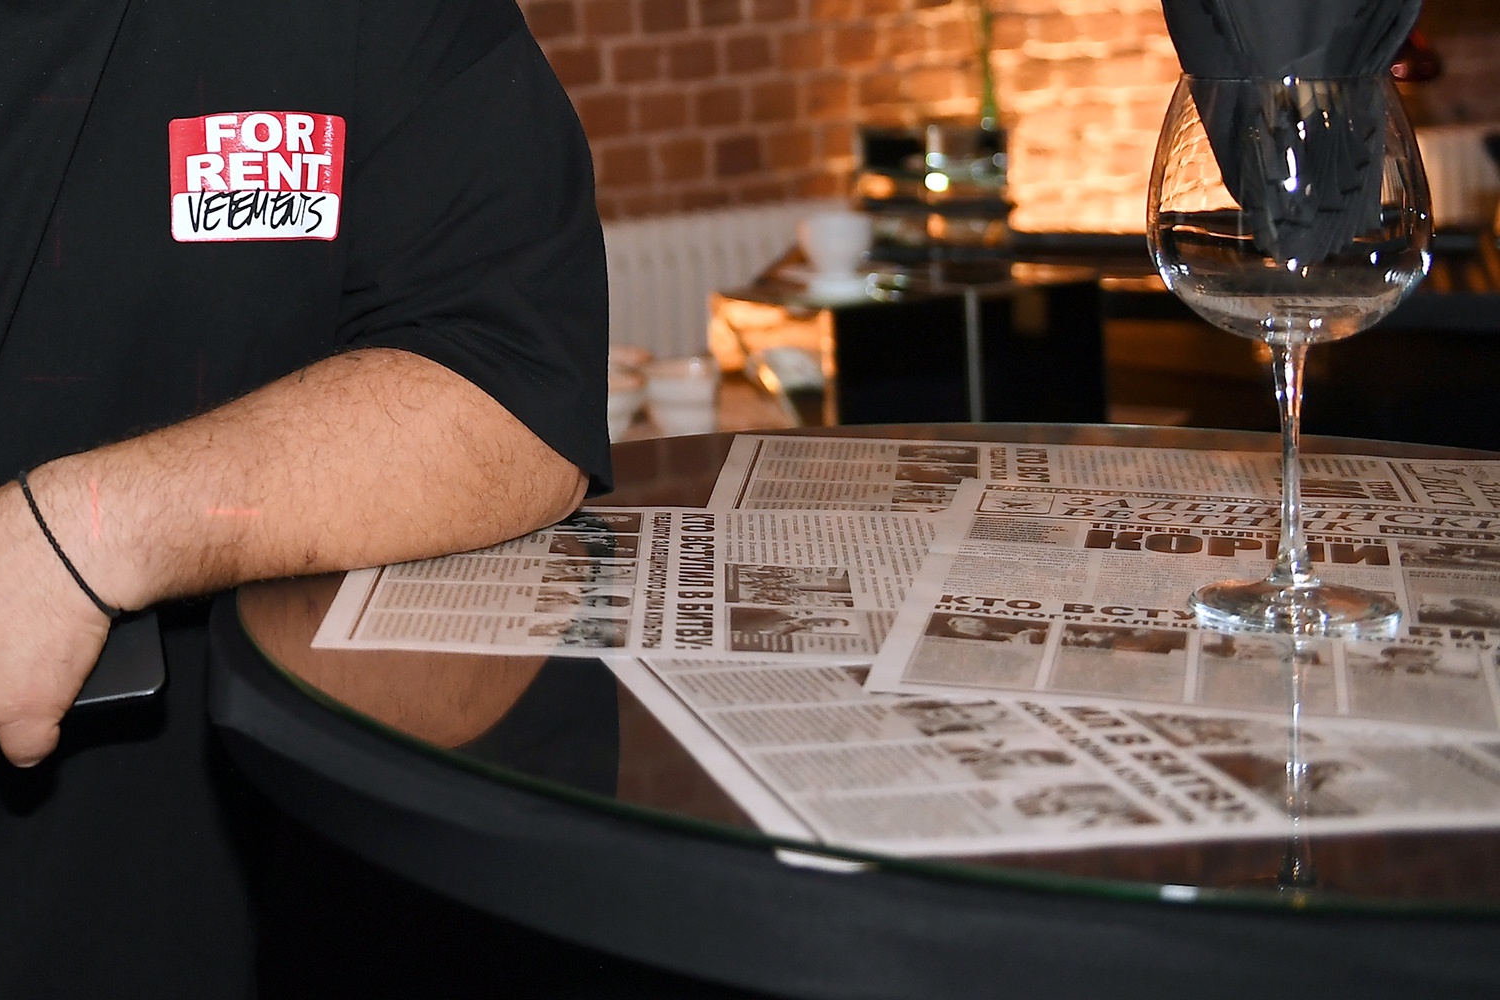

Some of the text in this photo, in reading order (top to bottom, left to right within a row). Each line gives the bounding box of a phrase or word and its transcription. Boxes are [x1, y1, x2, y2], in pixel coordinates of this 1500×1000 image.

[205, 113, 315, 153] FOR
[186, 152, 332, 191] RENT
[188, 188, 326, 233] VETEMENTS
[1016, 447, 1049, 464] КТО
[990, 484, 1083, 494] ГЛАВНАЯ
[650, 512, 672, 539] ПЕДАГОГИ
[680, 513, 715, 533] КТО
[1058, 507, 1363, 533] ВЕСТНИК
[1084, 529, 1390, 566] КОРНИ
[1201, 528, 1386, 545] КУЛЬРНЫЕ
[678, 535, 715, 587] ВСТУПИЛ
[643, 589, 666, 610] ДОМА
[677, 590, 714, 599] В
[934, 604, 1081, 621] ПЕДАГОГИ
[938, 595, 1042, 610] КТО
[1408, 626, 1500, 641] БИ
